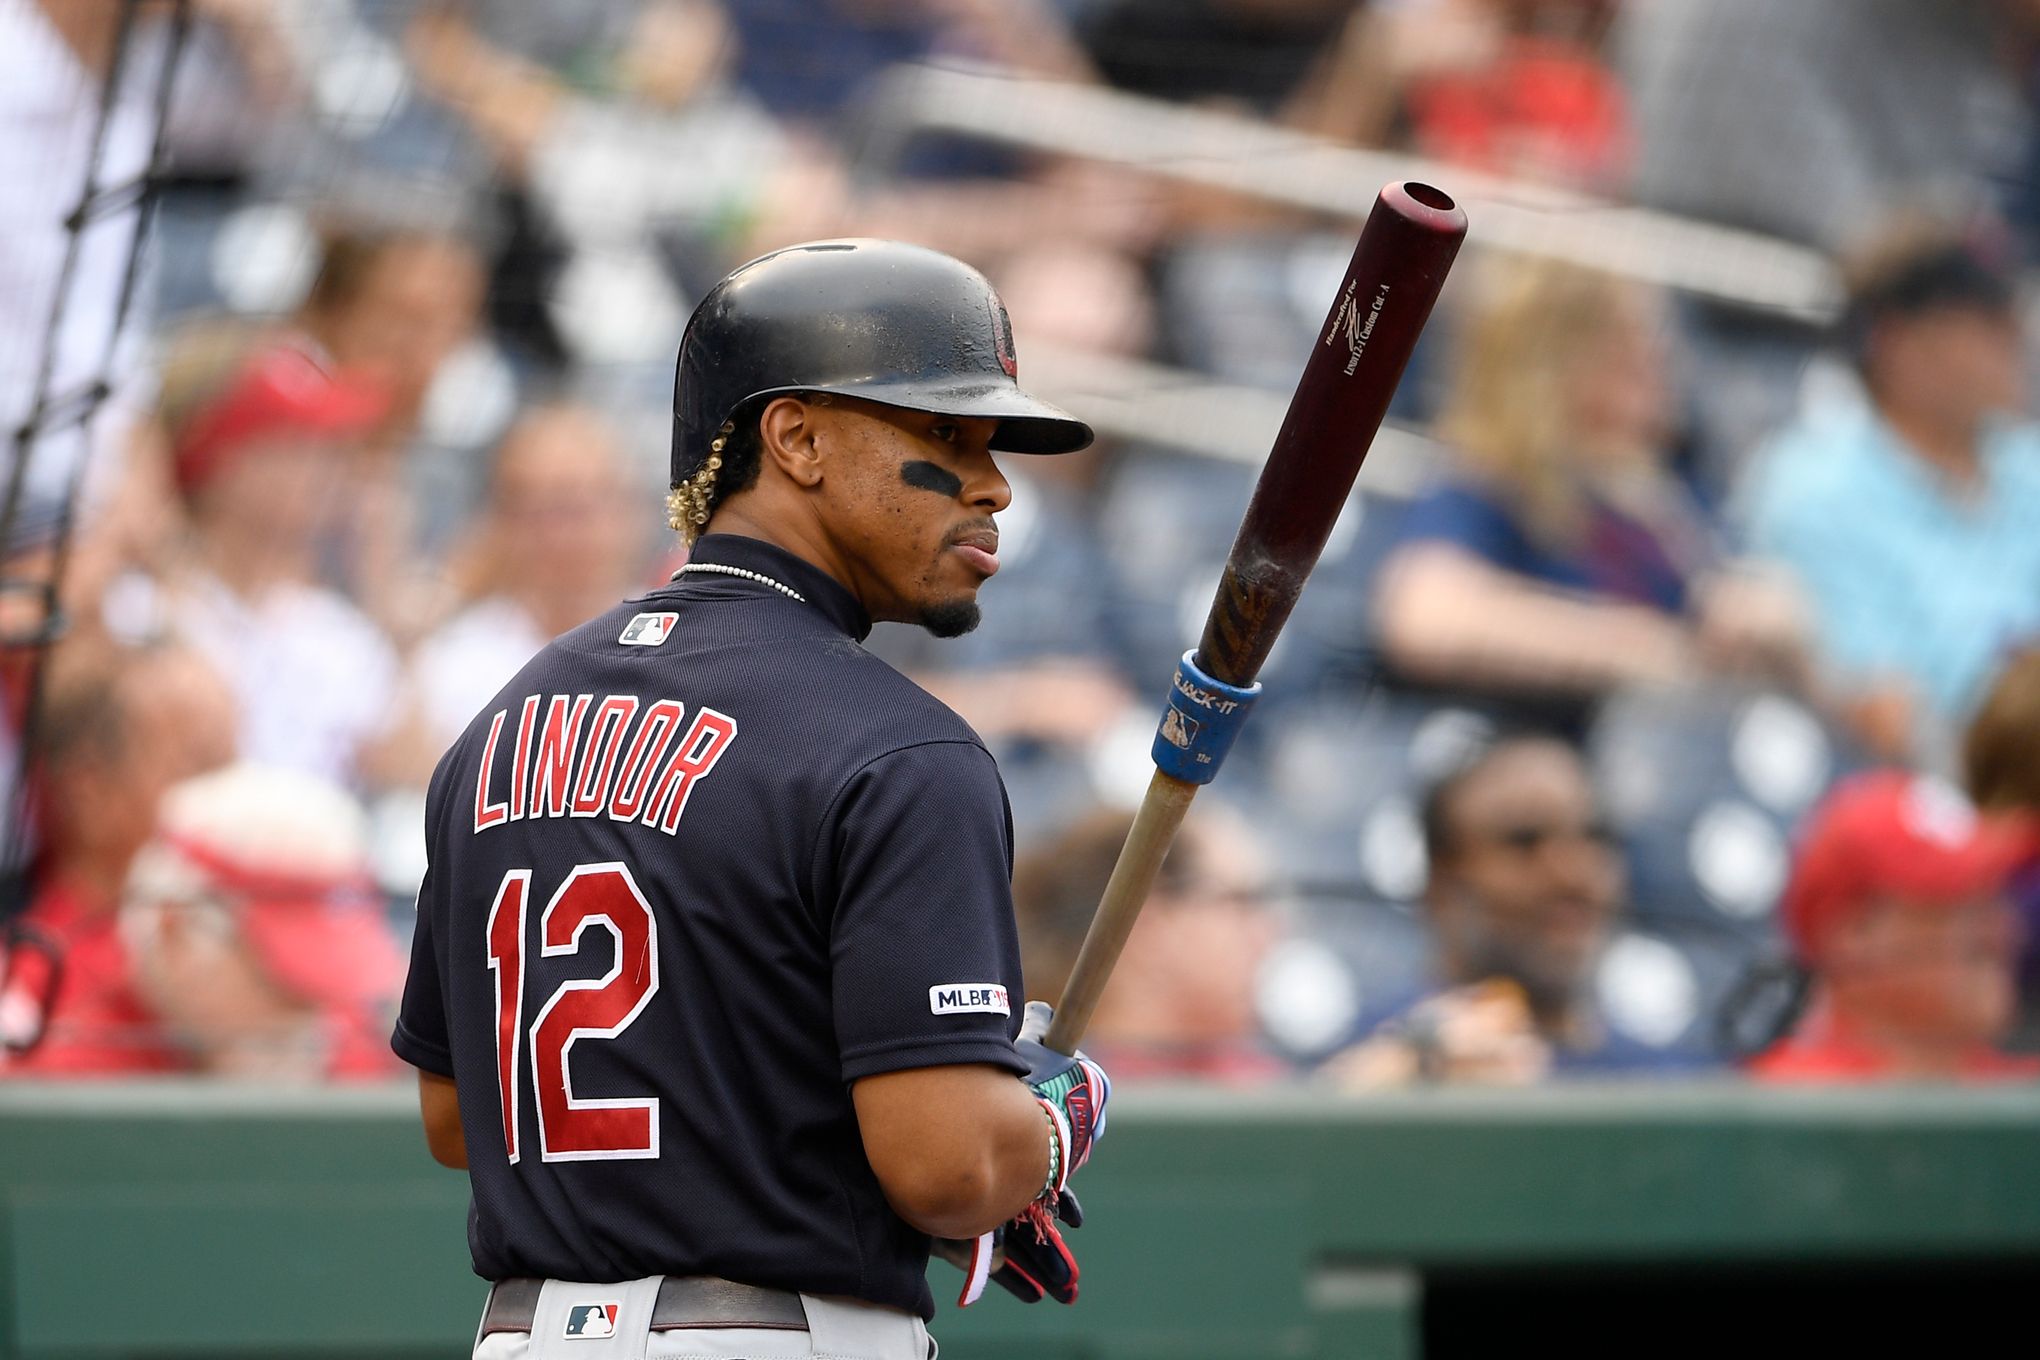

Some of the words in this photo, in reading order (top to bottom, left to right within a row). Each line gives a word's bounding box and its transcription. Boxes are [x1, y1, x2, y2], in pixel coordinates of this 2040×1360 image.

[1325, 293, 1351, 347] Handcrafted
[1347, 278, 1357, 295] For
[1359, 310, 1379, 340] Custom
[1371, 295, 1385, 311] Cut
[1380, 284, 1390, 293] A
[474, 694, 738, 836] LINDOR
[486, 861, 660, 1166] 12
[938, 989, 981, 1009] MLB
